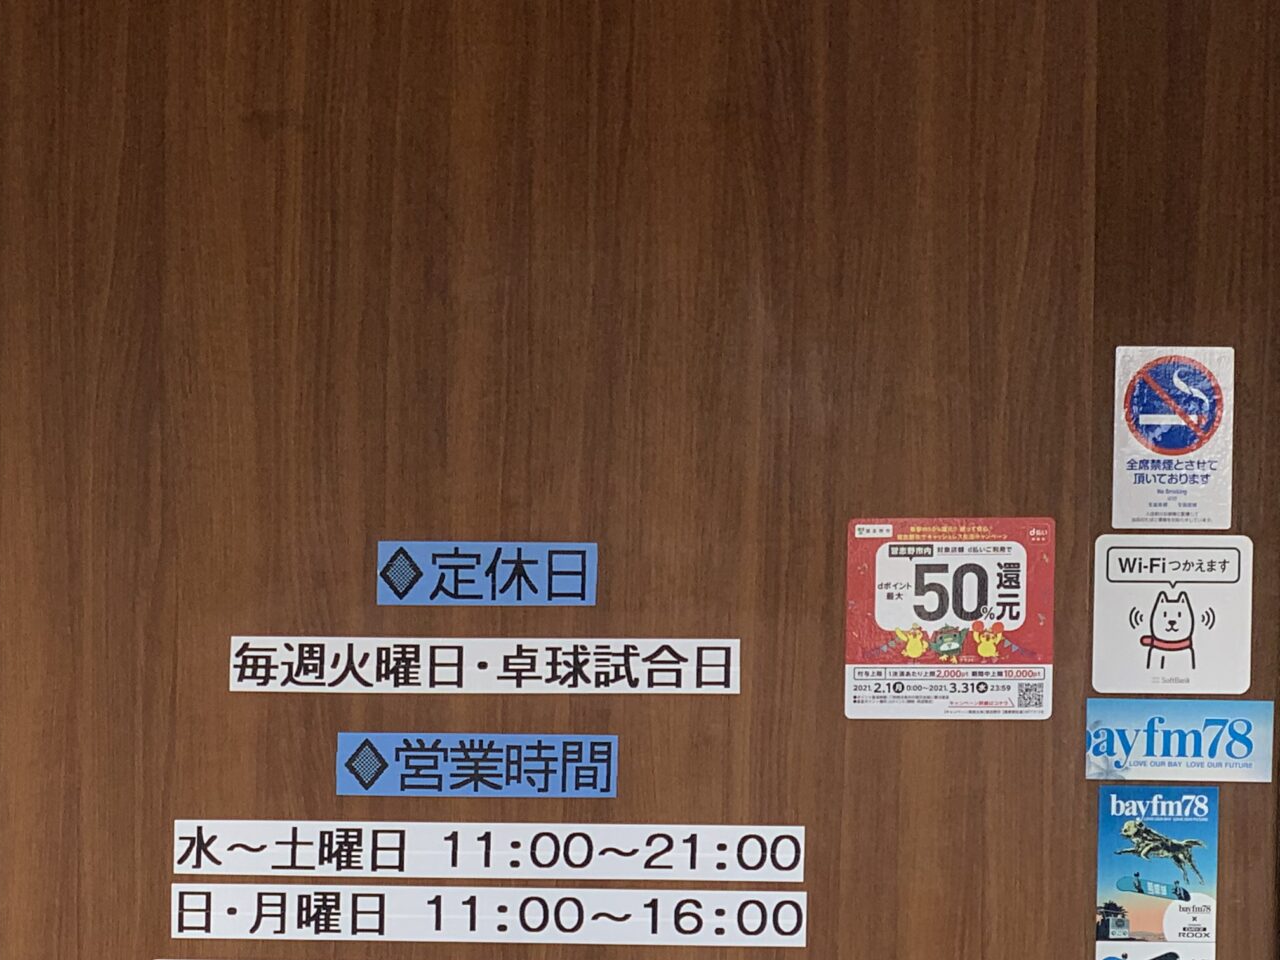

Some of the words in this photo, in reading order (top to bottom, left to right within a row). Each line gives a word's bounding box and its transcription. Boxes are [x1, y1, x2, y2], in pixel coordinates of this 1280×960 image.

[1126, 459, 1218, 471] 全席禁煙とさせて
[1133, 472, 1211, 485] 頂いております
[1029, 528, 1048, 536] d払い
[1118, 557, 1167, 574] Wi-Fi
[1168, 558, 1231, 573] つかえます
[877, 582, 912, 590] dポイント
[996, 562, 1021, 621] 還元
[886, 592, 904, 600] 最大
[233, 641, 734, 688] 毎週火曜日・卓球試合日
[1161, 676, 1191, 684] SoftBank
[1086, 716, 1254, 769] ayfm78
[1207, 761, 1223, 769] OUR
[1110, 794, 1209, 821] bayfm78
[177, 826, 407, 873] 水〜土曜日
[443, 831, 802, 873] 11:00〜21:00
[177, 891, 386, 937] 日・月曜日
[427, 895, 803, 937] 11:00〜16:00
